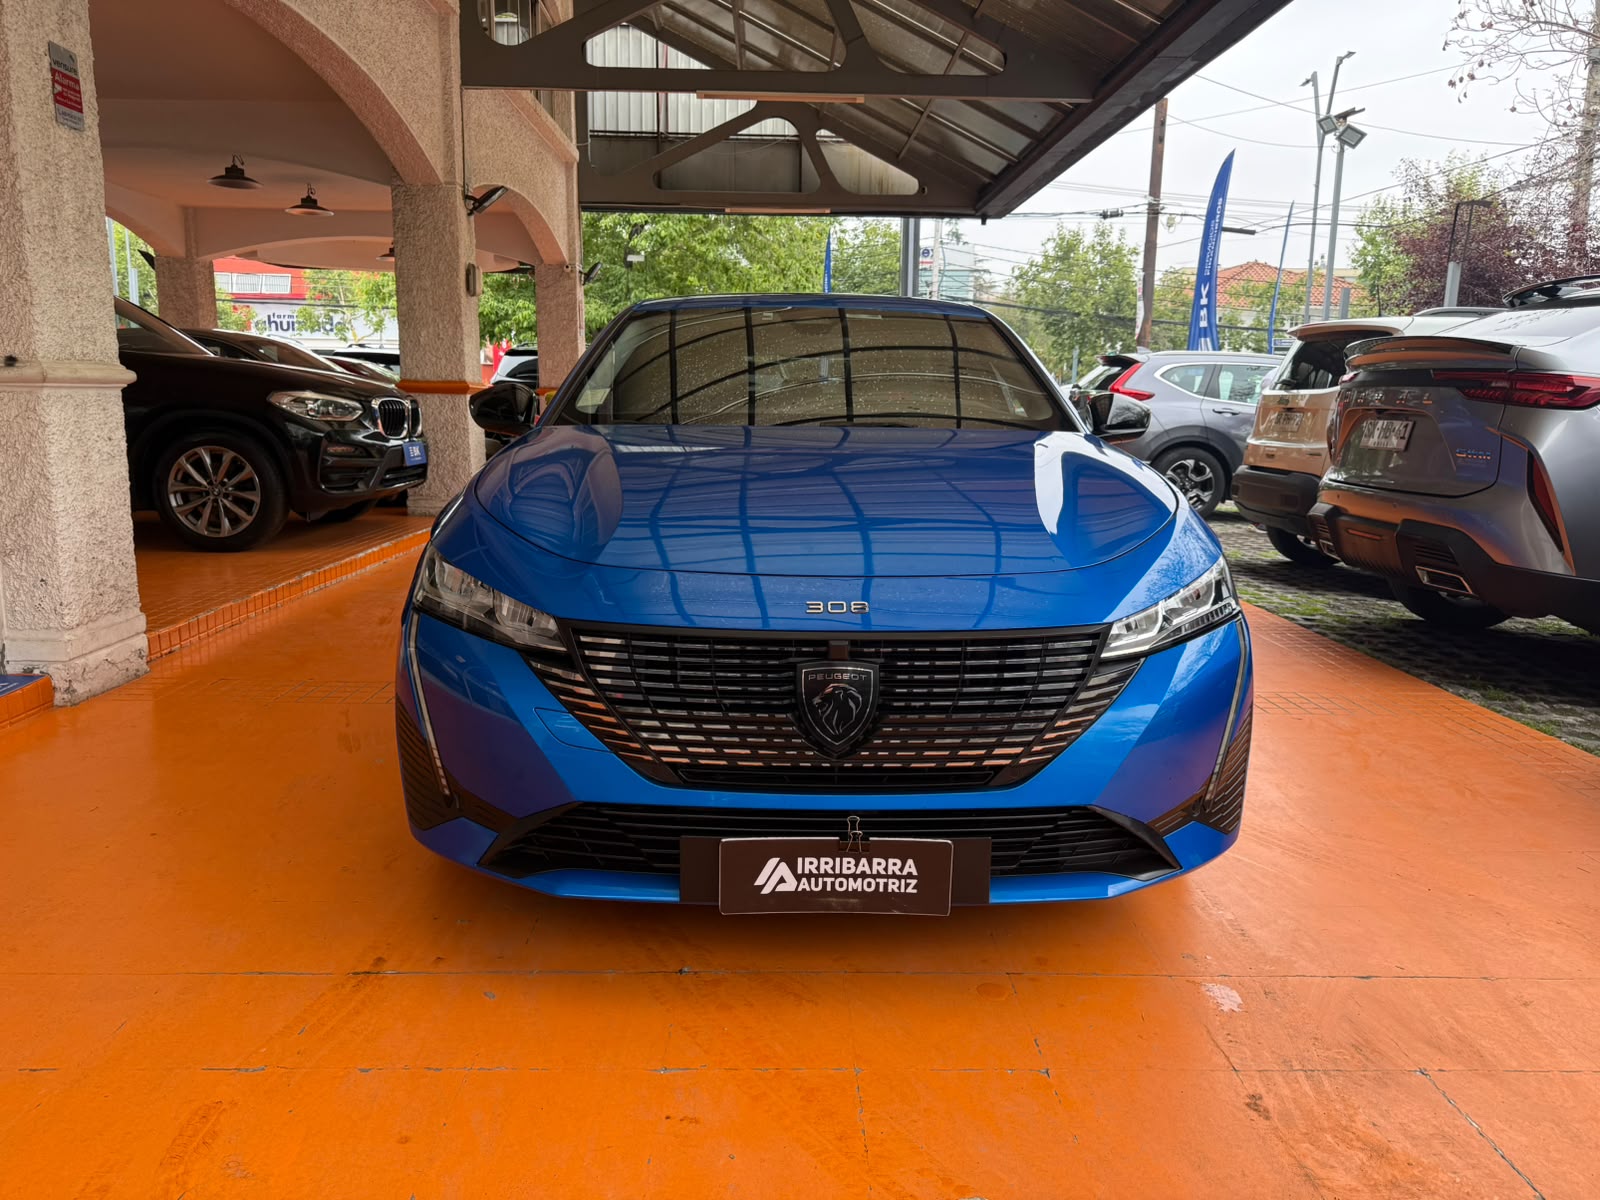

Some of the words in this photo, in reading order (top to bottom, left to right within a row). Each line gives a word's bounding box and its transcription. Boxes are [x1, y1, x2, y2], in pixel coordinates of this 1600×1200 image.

[54, 71, 80, 91] Alarma
[805, 601, 870, 614] 308
[808, 672, 868, 681] PEUGEOT
[797, 857, 918, 876] IRRIBARRA
[796, 877, 918, 894] AUTOMOTRIZ
